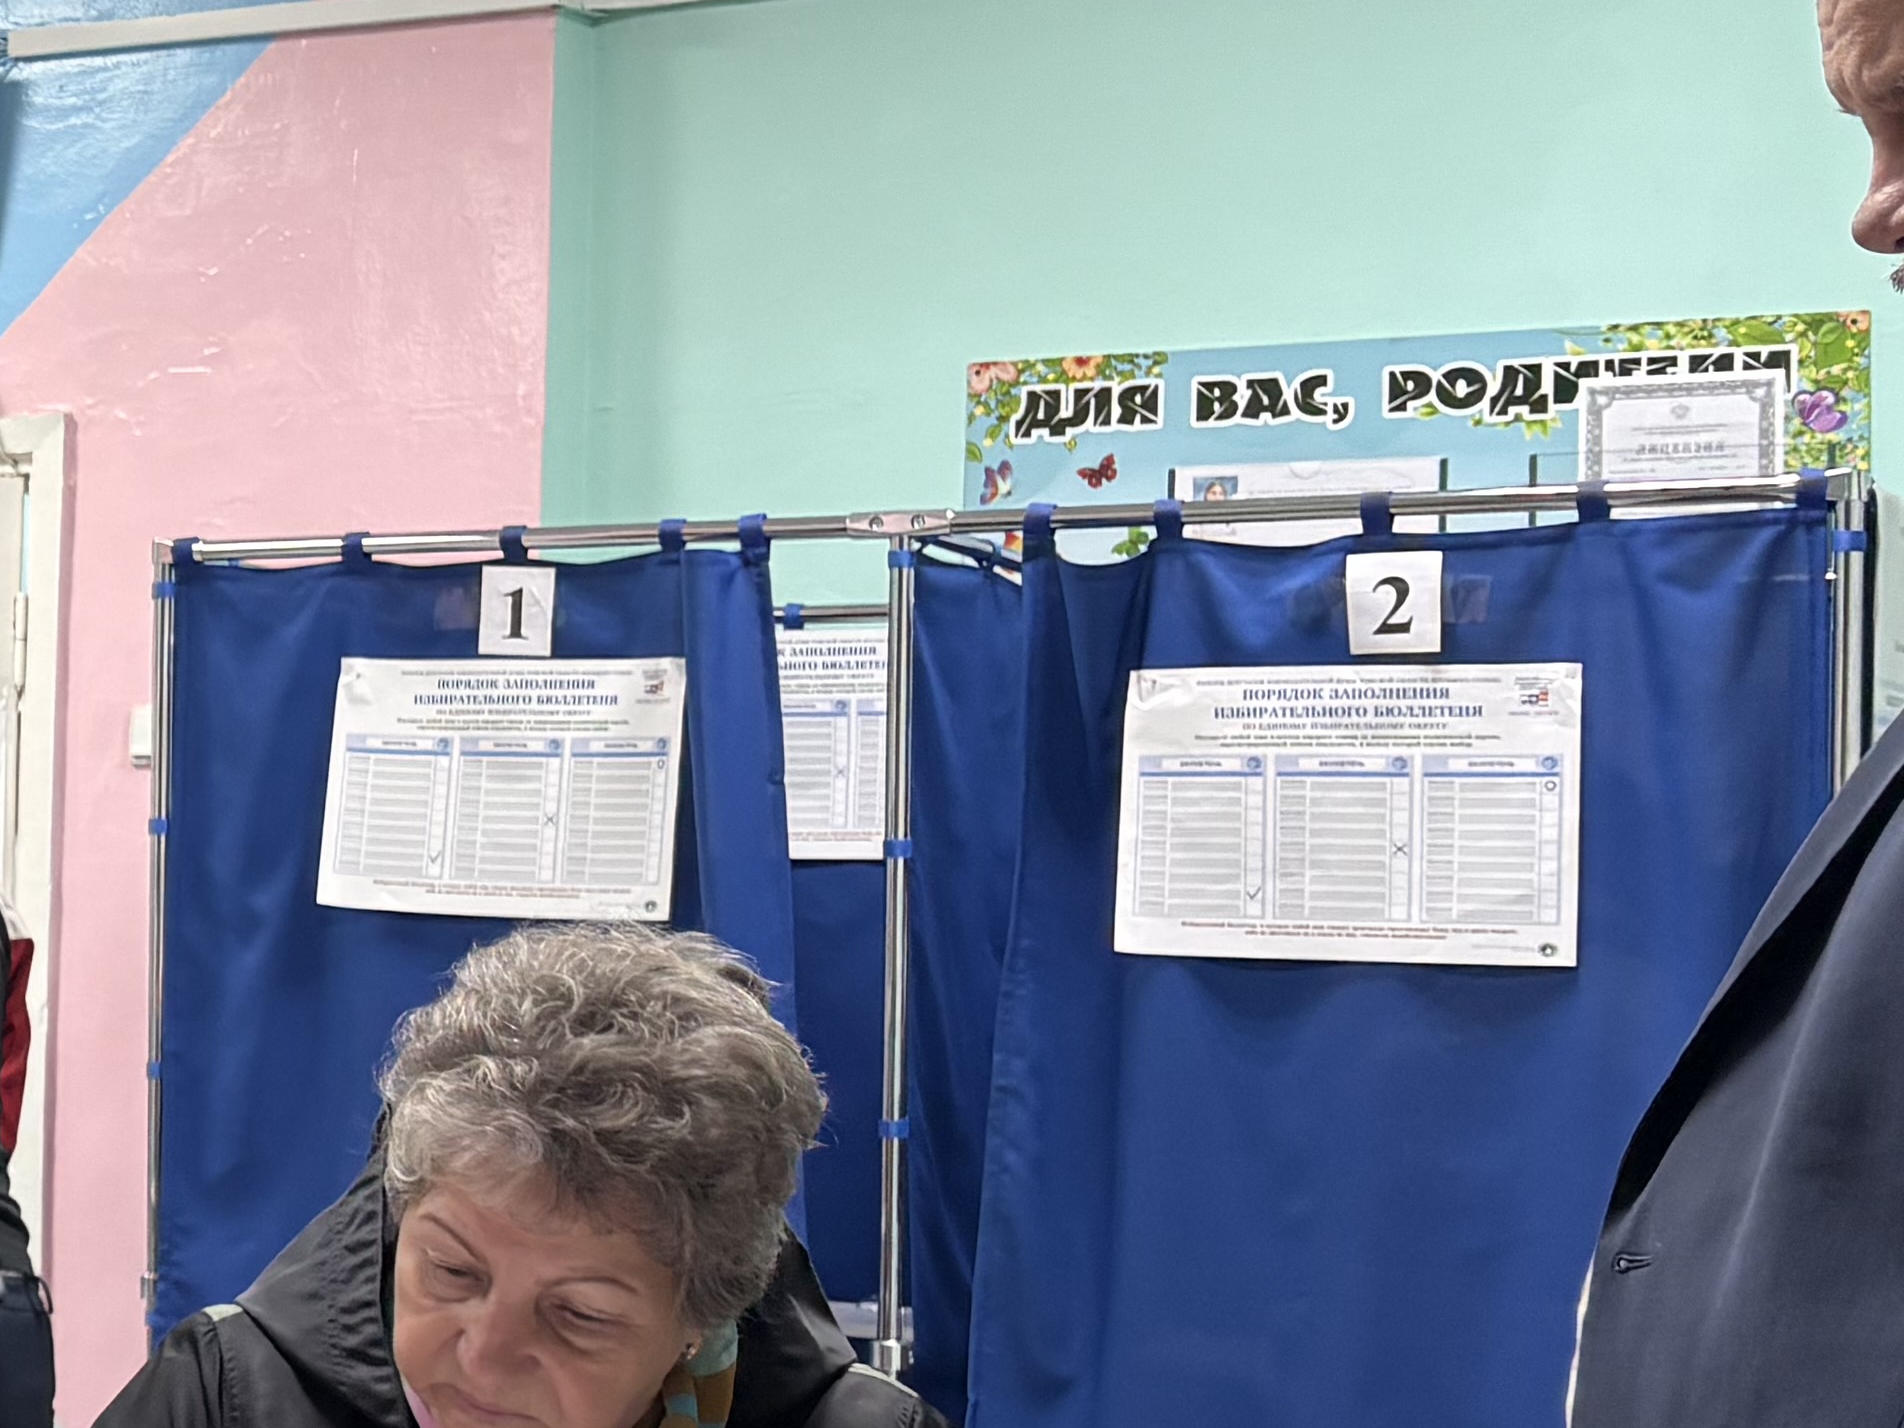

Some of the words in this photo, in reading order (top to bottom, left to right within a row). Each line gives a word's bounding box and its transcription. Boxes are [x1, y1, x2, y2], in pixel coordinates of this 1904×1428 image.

[1015, 385, 1160, 439] ДЛЯ
[1195, 376, 1350, 426] ВАС,
[502, 585, 530, 640] 1
[1372, 575, 1415, 638] 2
[1213, 705, 1369, 720] ИЗБИРАТЕЛЬНОГО
[1373, 704, 1484, 719] БЮЛЛЕТЕНЯ
[1242, 688, 1326, 702] ПОРЯДОК
[1328, 686, 1451, 700] ЗАПОЛНЕНИЯ
